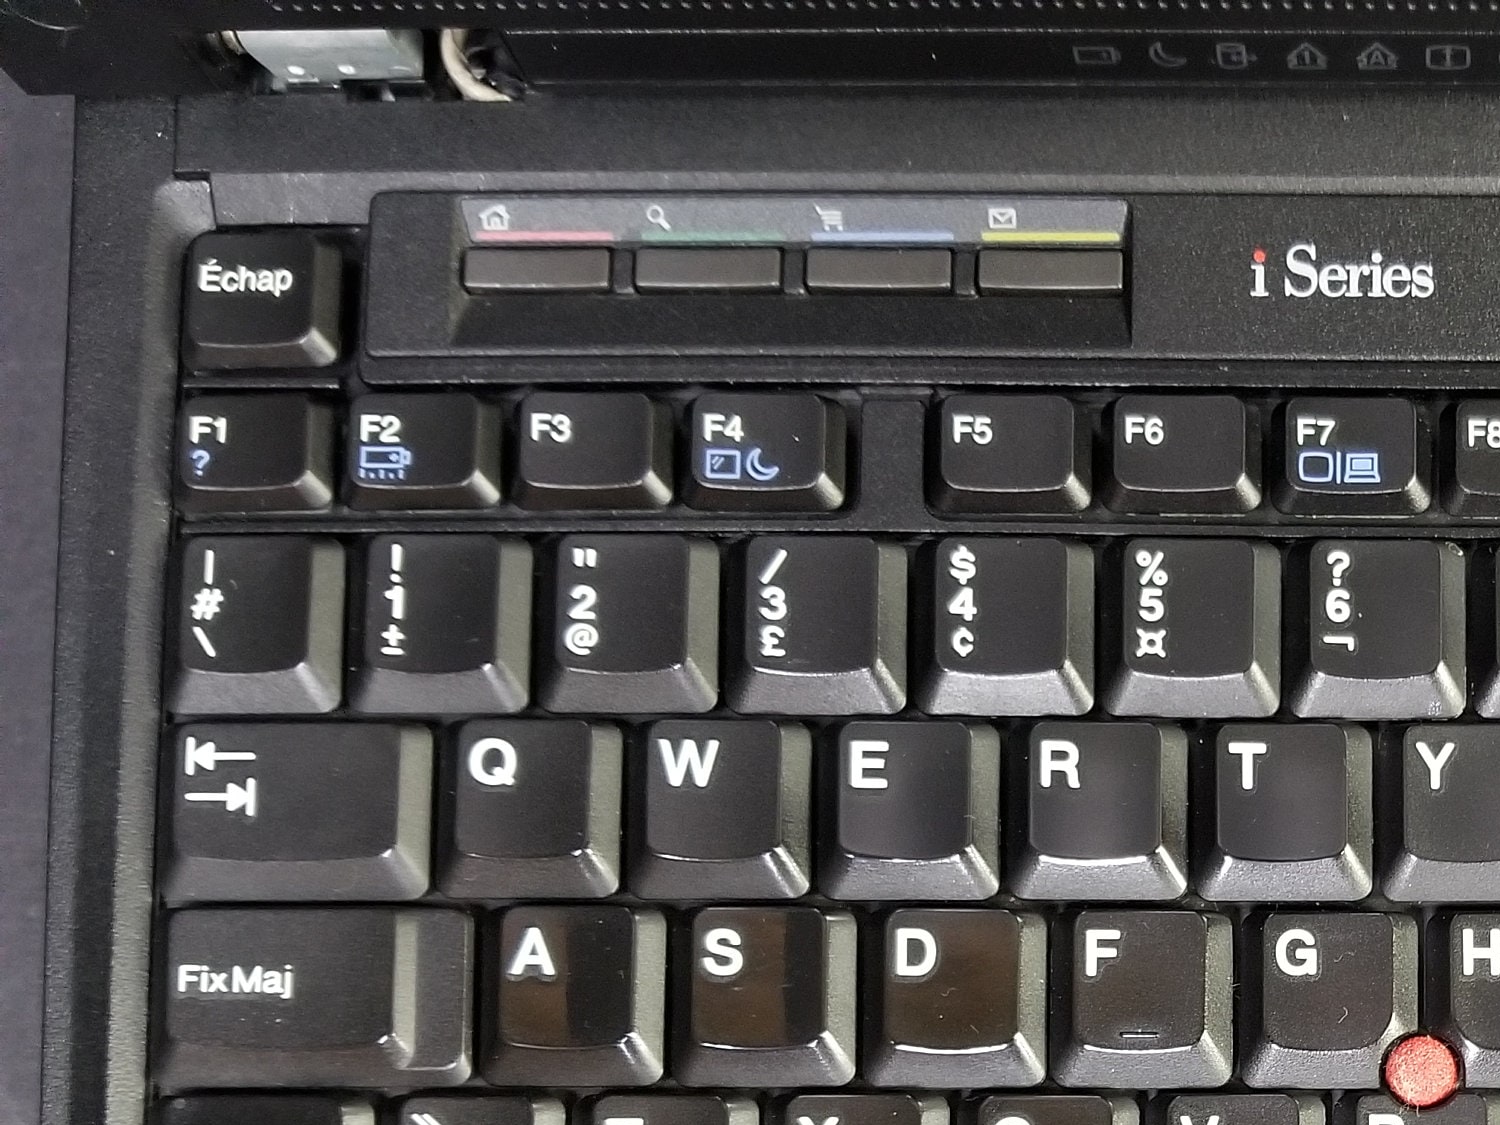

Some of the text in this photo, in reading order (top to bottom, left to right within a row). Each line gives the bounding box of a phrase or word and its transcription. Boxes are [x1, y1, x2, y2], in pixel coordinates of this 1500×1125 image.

[198, 258, 293, 298] Échap
[1250, 242, 1435, 298] i Series
[190, 415, 227, 444] F1
[360, 414, 401, 443] F2
[531, 412, 572, 443] F3
[703, 413, 745, 442] F4
[953, 414, 993, 445] F5
[1125, 415, 1164, 445] F6
[1297, 417, 1336, 446] F7
[384, 585, 405, 620] 1
[568, 584, 597, 620] 2
[759, 586, 788, 621] 3
[948, 586, 978, 622] 4
[1138, 587, 1165, 622] 5
[1325, 588, 1351, 623] 6
[468, 737, 518, 786] Q
[657, 738, 720, 788] W
[850, 740, 890, 789] E
[1040, 739, 1081, 789] R
[1228, 741, 1267, 790] T
[1415, 741, 1455, 790] Y
[508, 927, 556, 976] A
[702, 927, 744, 976] S
[895, 927, 937, 977] D
[1085, 929, 1121, 977] F
[1275, 928, 1318, 977] G
